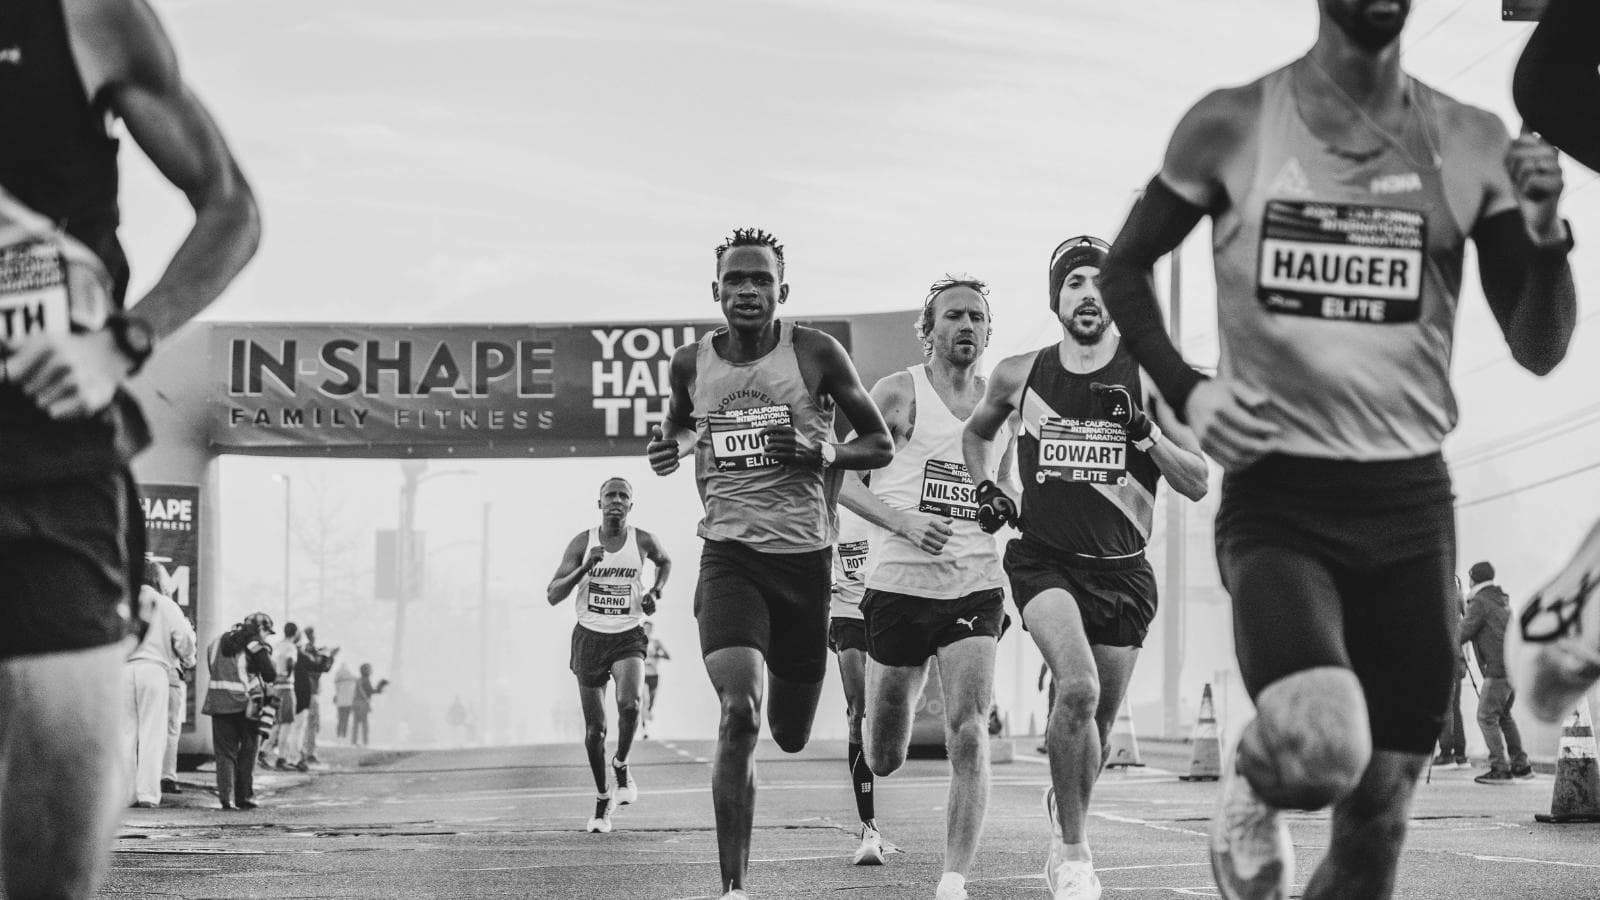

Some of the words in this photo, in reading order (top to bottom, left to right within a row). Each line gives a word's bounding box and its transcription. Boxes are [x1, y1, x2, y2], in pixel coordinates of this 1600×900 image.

[1273, 249, 1408, 287] HAUGER
[1321, 296, 1386, 322] ELITE
[0, 303, 44, 339] TH
[591, 326, 696, 360] YOU
[229, 407, 368, 428] FAMILY
[394, 409, 554, 430] FITNESS
[593, 397, 670, 437] TH
[736, 411, 790, 423] INTERNATIONAL
[748, 404, 789, 415] CALIFORNIA
[1086, 433, 1126, 442] MARATHON
[1043, 443, 1123, 465] COWART
[1072, 469, 1107, 482] ELITE
[926, 482, 978, 504] NILSSO
[139, 498, 192, 521] HAPE
[950, 507, 976, 519] ELITE
[588, 567, 637, 578] OLYMPIKUS
[846, 556, 867, 569] ROT
[595, 595, 625, 606] BARNO
